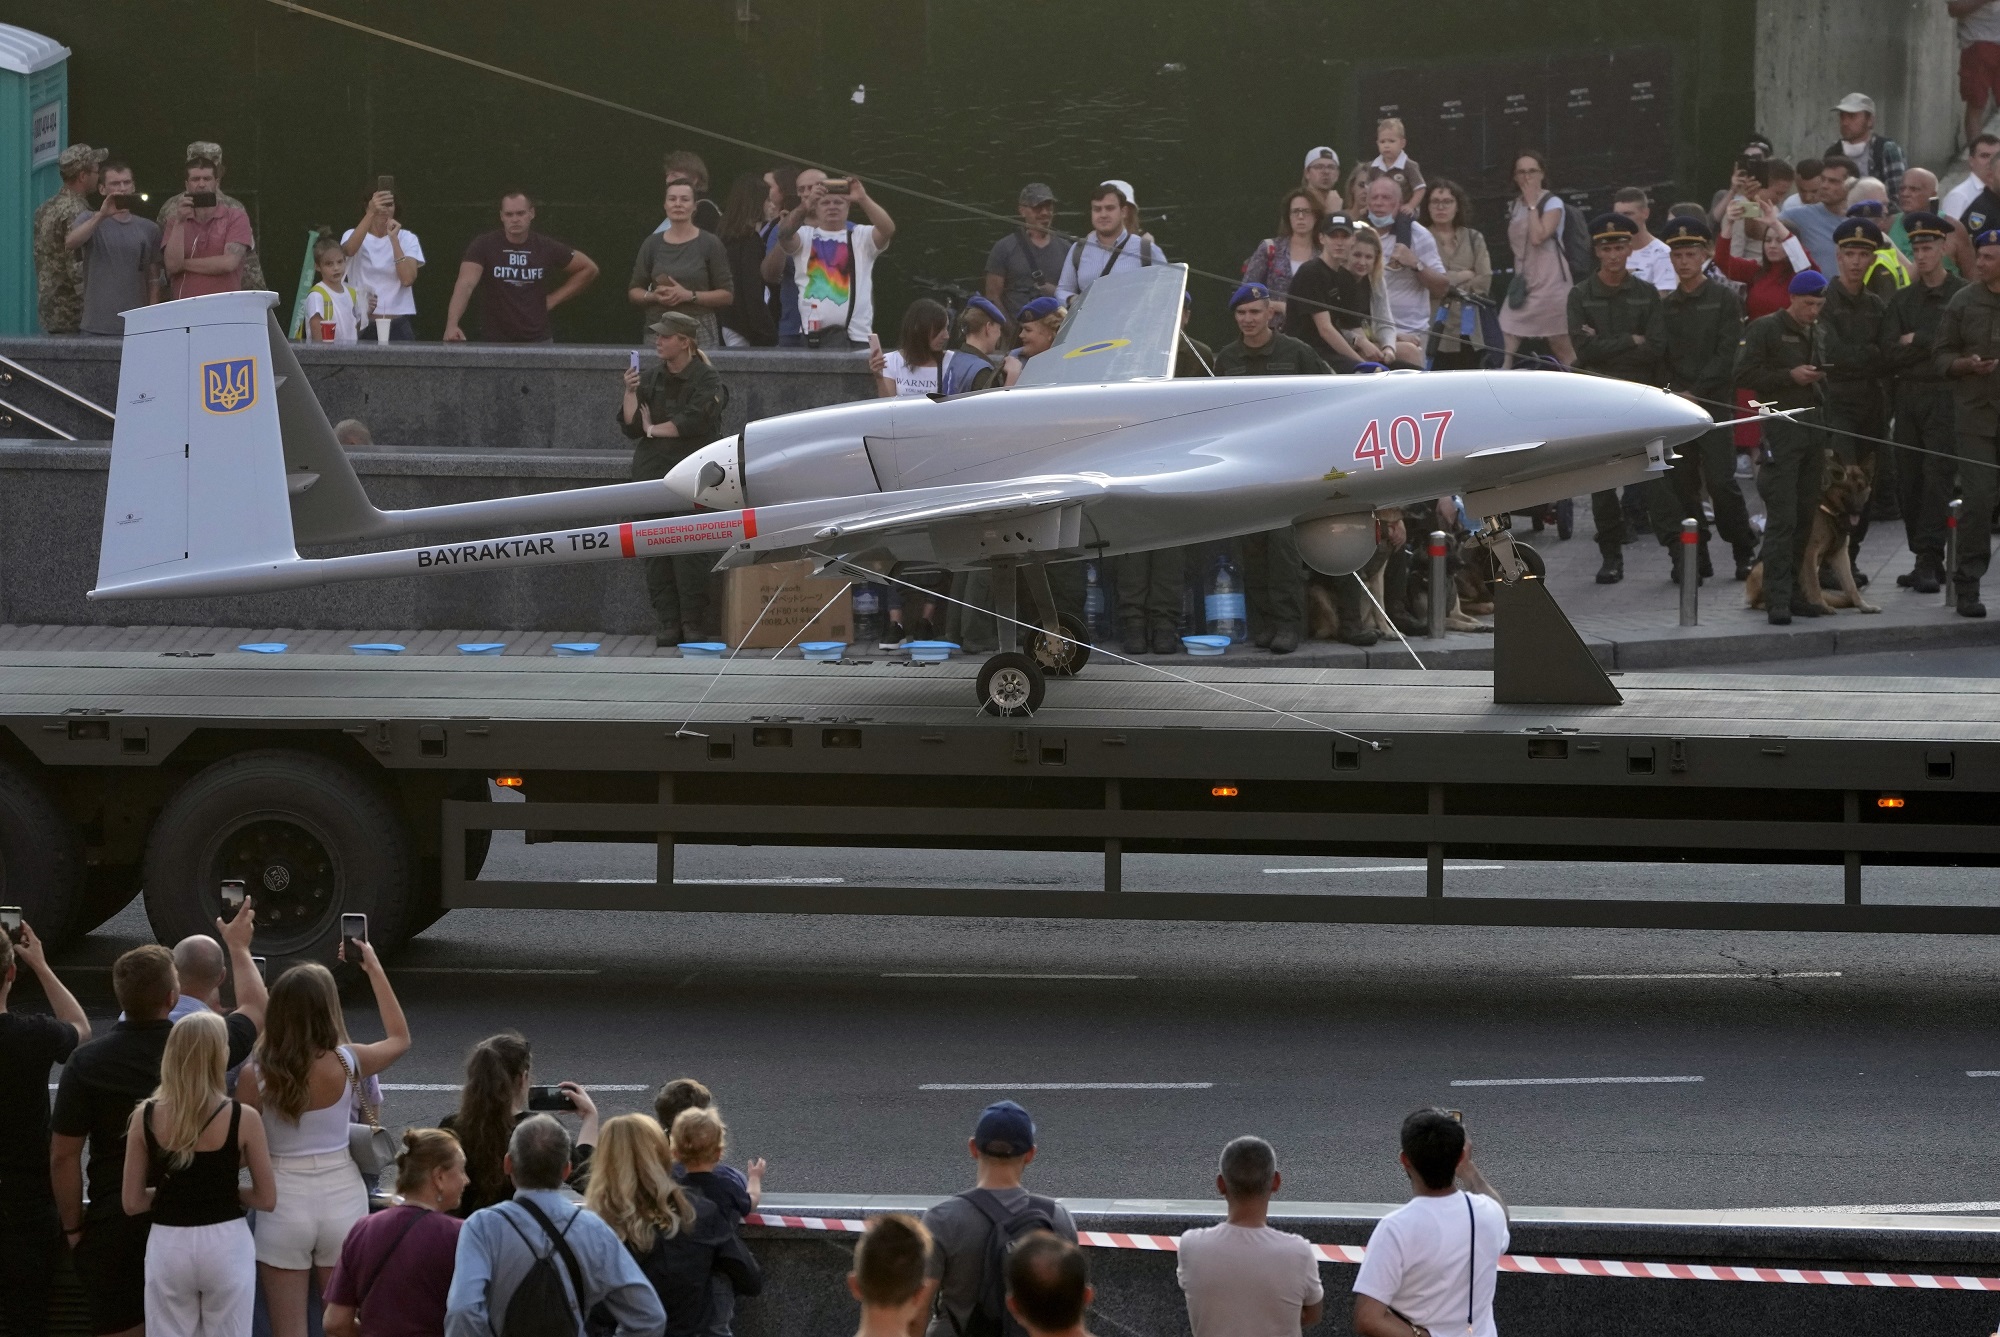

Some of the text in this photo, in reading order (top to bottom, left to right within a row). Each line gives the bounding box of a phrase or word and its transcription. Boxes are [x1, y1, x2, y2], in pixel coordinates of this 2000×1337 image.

[509, 253, 527, 266] BIG
[493, 266, 544, 280] CITY LIFE
[896, 377, 938, 388] WARNIN
[1353, 409, 1455, 471] 407
[635, 519, 743, 537] НЕБЕЗПЕЧНО ПРОПЕЛЕР
[647, 530, 733, 546] DANGER PROPELLER
[417, 531, 610, 568] BAYRAKTAR TB2
